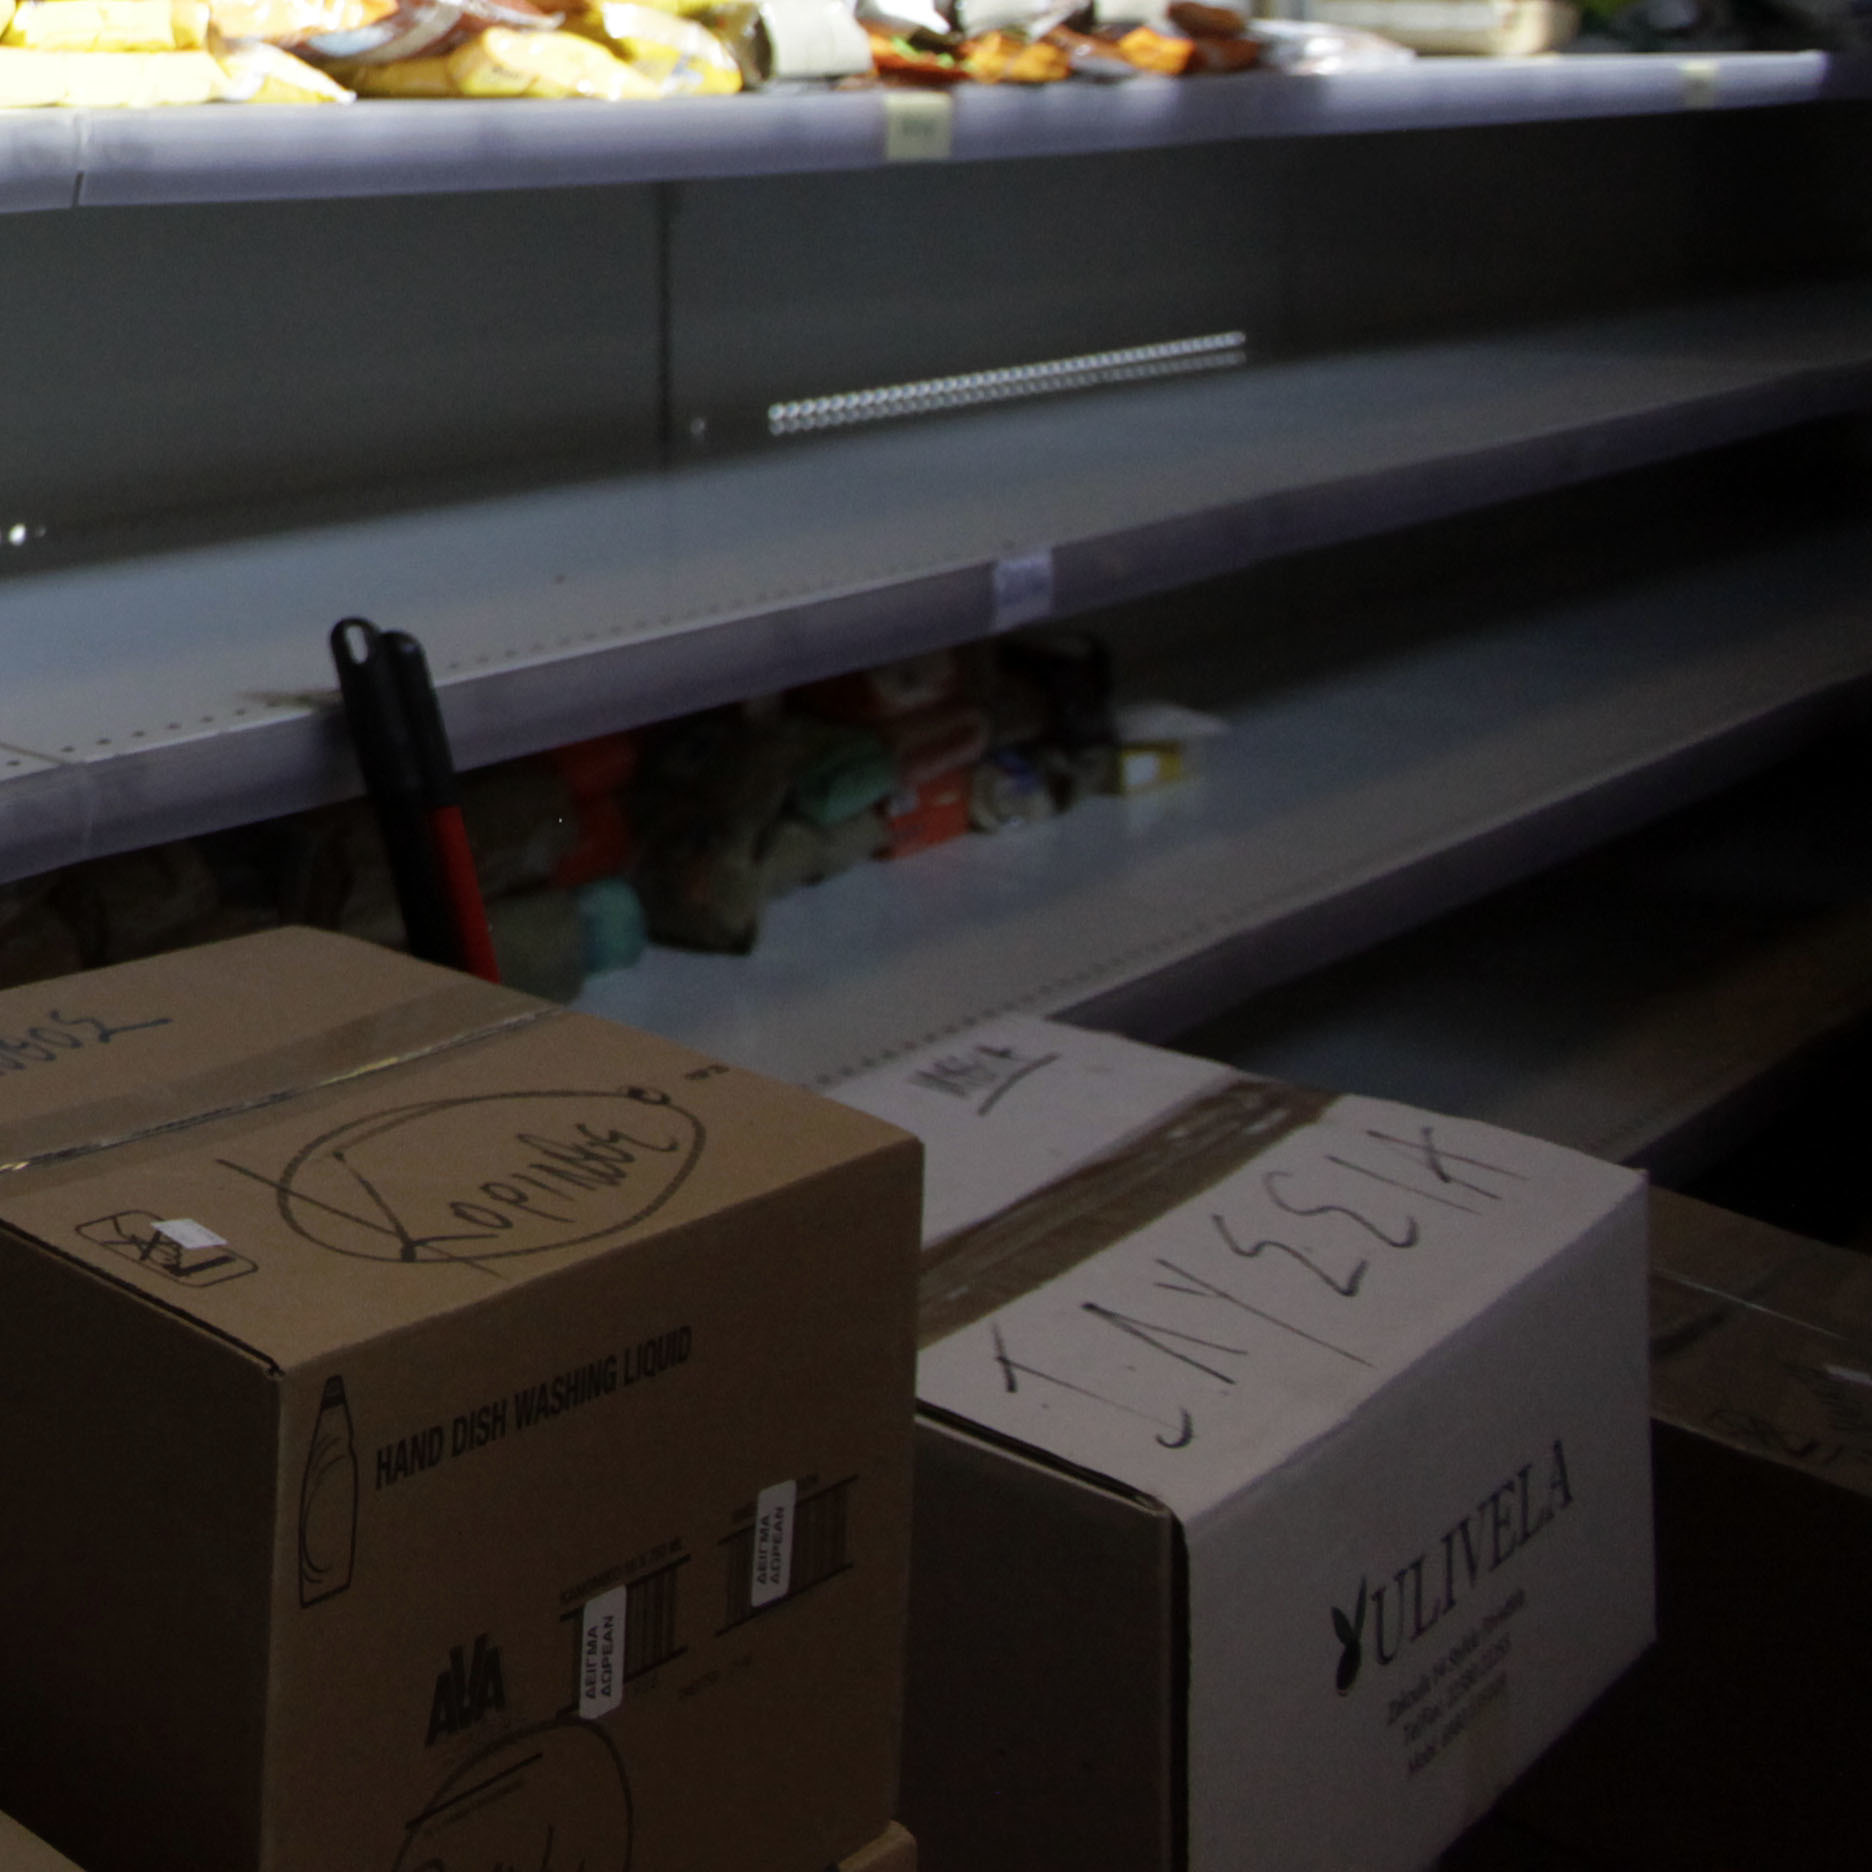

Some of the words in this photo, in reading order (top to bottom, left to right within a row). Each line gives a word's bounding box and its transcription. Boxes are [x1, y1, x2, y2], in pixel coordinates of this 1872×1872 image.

[375, 1425, 444, 1490] HAND
[451, 1398, 507, 1458] DISH
[513, 1354, 618, 1430] WASHING
[622, 1325, 692, 1386] LIQUID
